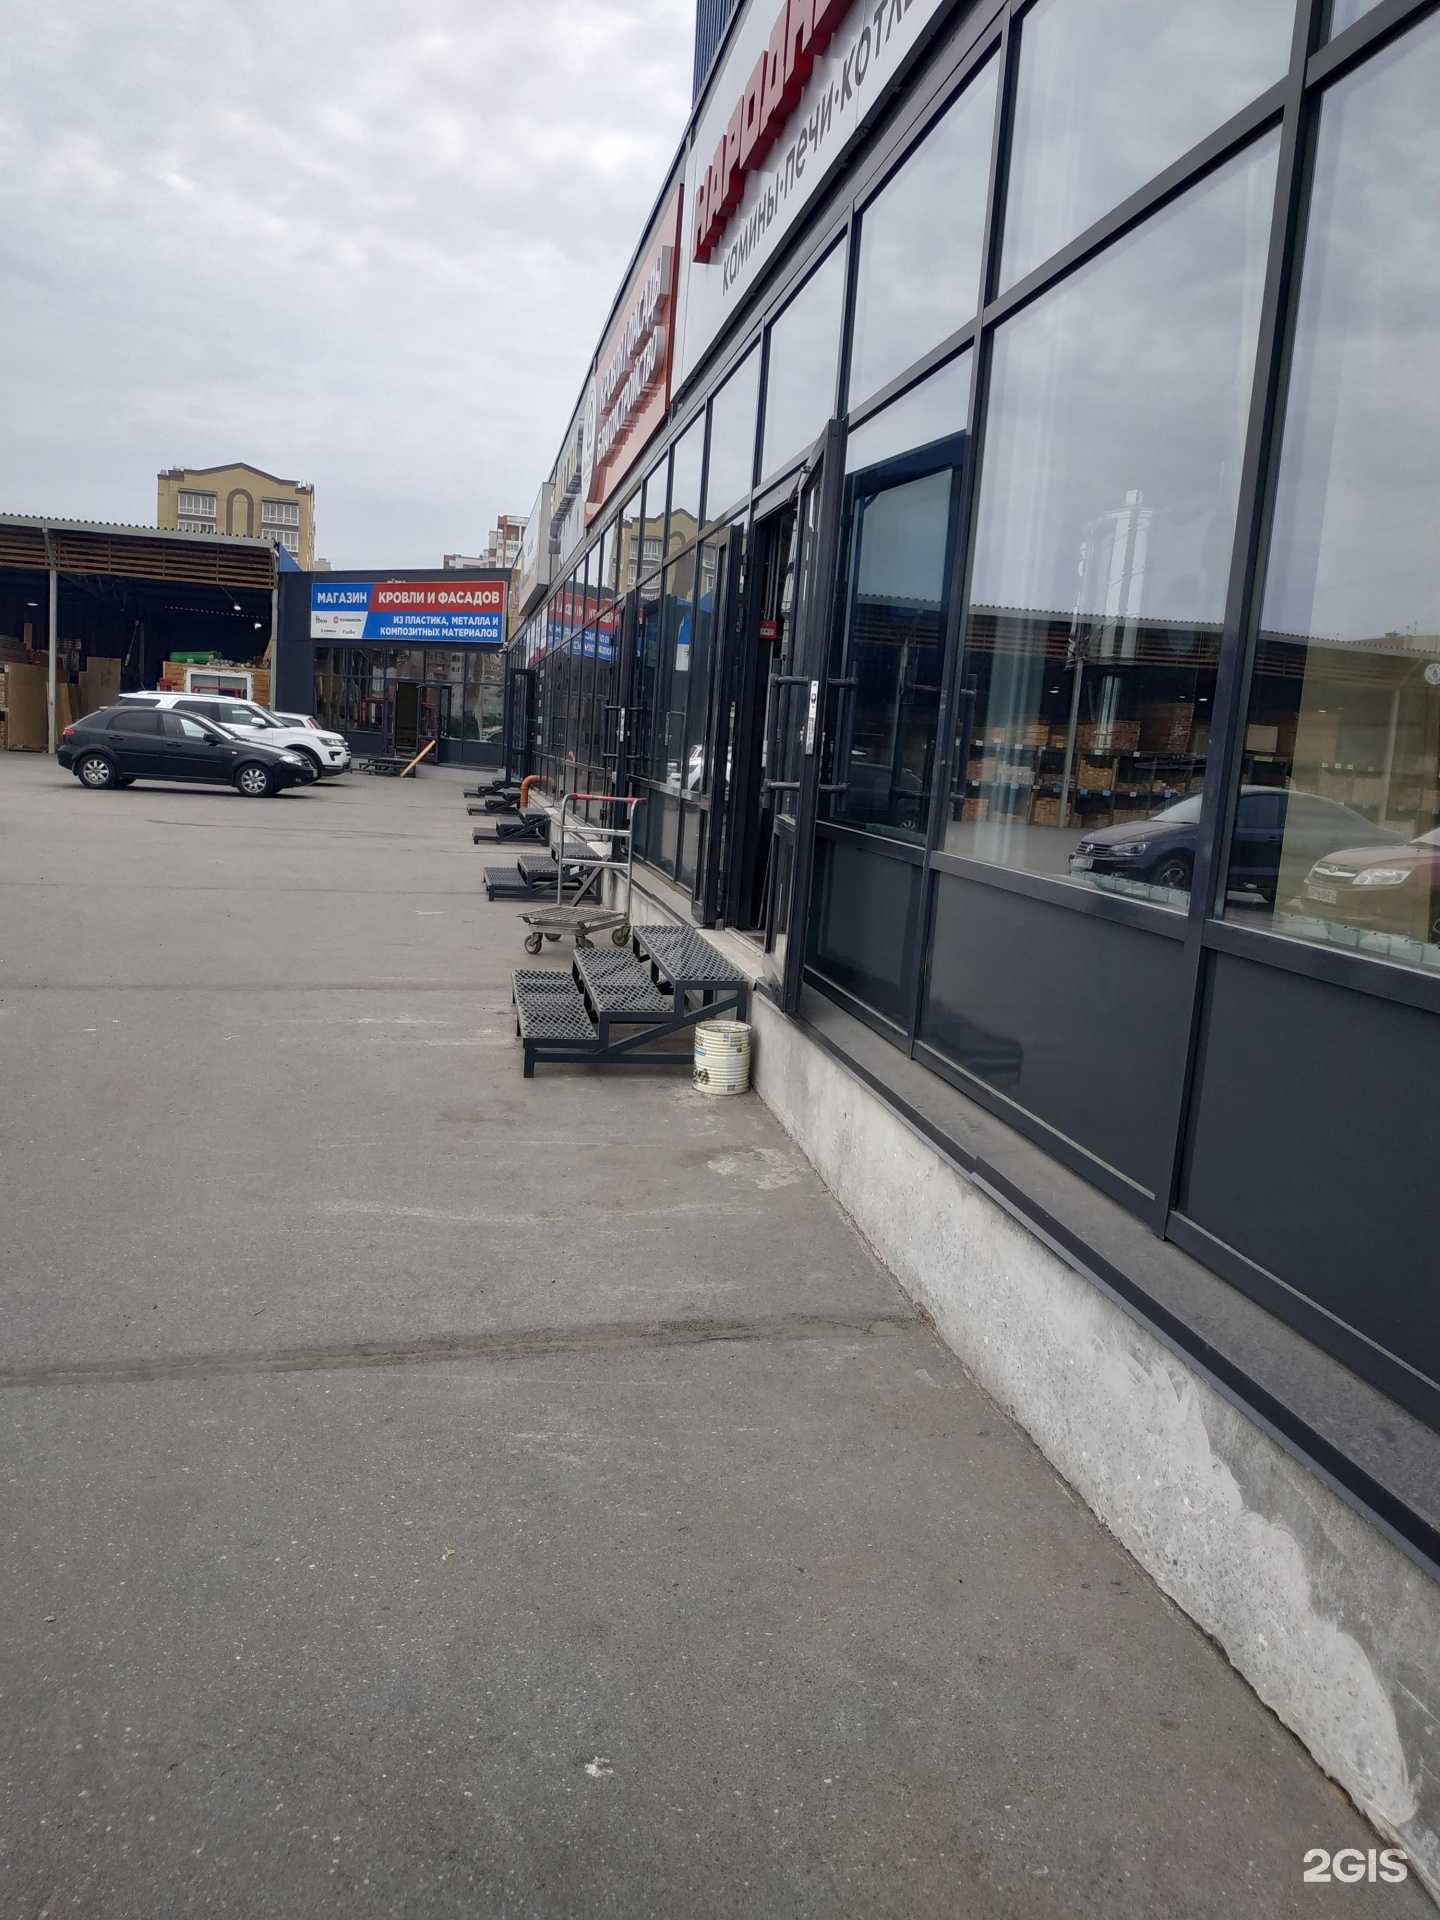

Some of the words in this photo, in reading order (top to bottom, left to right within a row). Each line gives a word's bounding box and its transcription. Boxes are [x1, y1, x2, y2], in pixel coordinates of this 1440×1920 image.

[693, 0, 842, 263] НАРОДН
[317, 592, 368, 604] МАГАЗИН
[378, 591, 425, 604] КРОВЛИ
[427, 592, 436, 604] И
[438, 591, 500, 606] ФАСАДОВ
[393, 615, 404, 625] ИЗ
[405, 615, 449, 627] ПЛАСТИКА,
[451, 616, 491, 626] МЕТАЛЛА
[492, 616, 499, 626] И
[380, 627, 440, 637] КОМПОЗИТНЫХ
[442, 628, 498, 638] МАТЕРИАЛОВ
